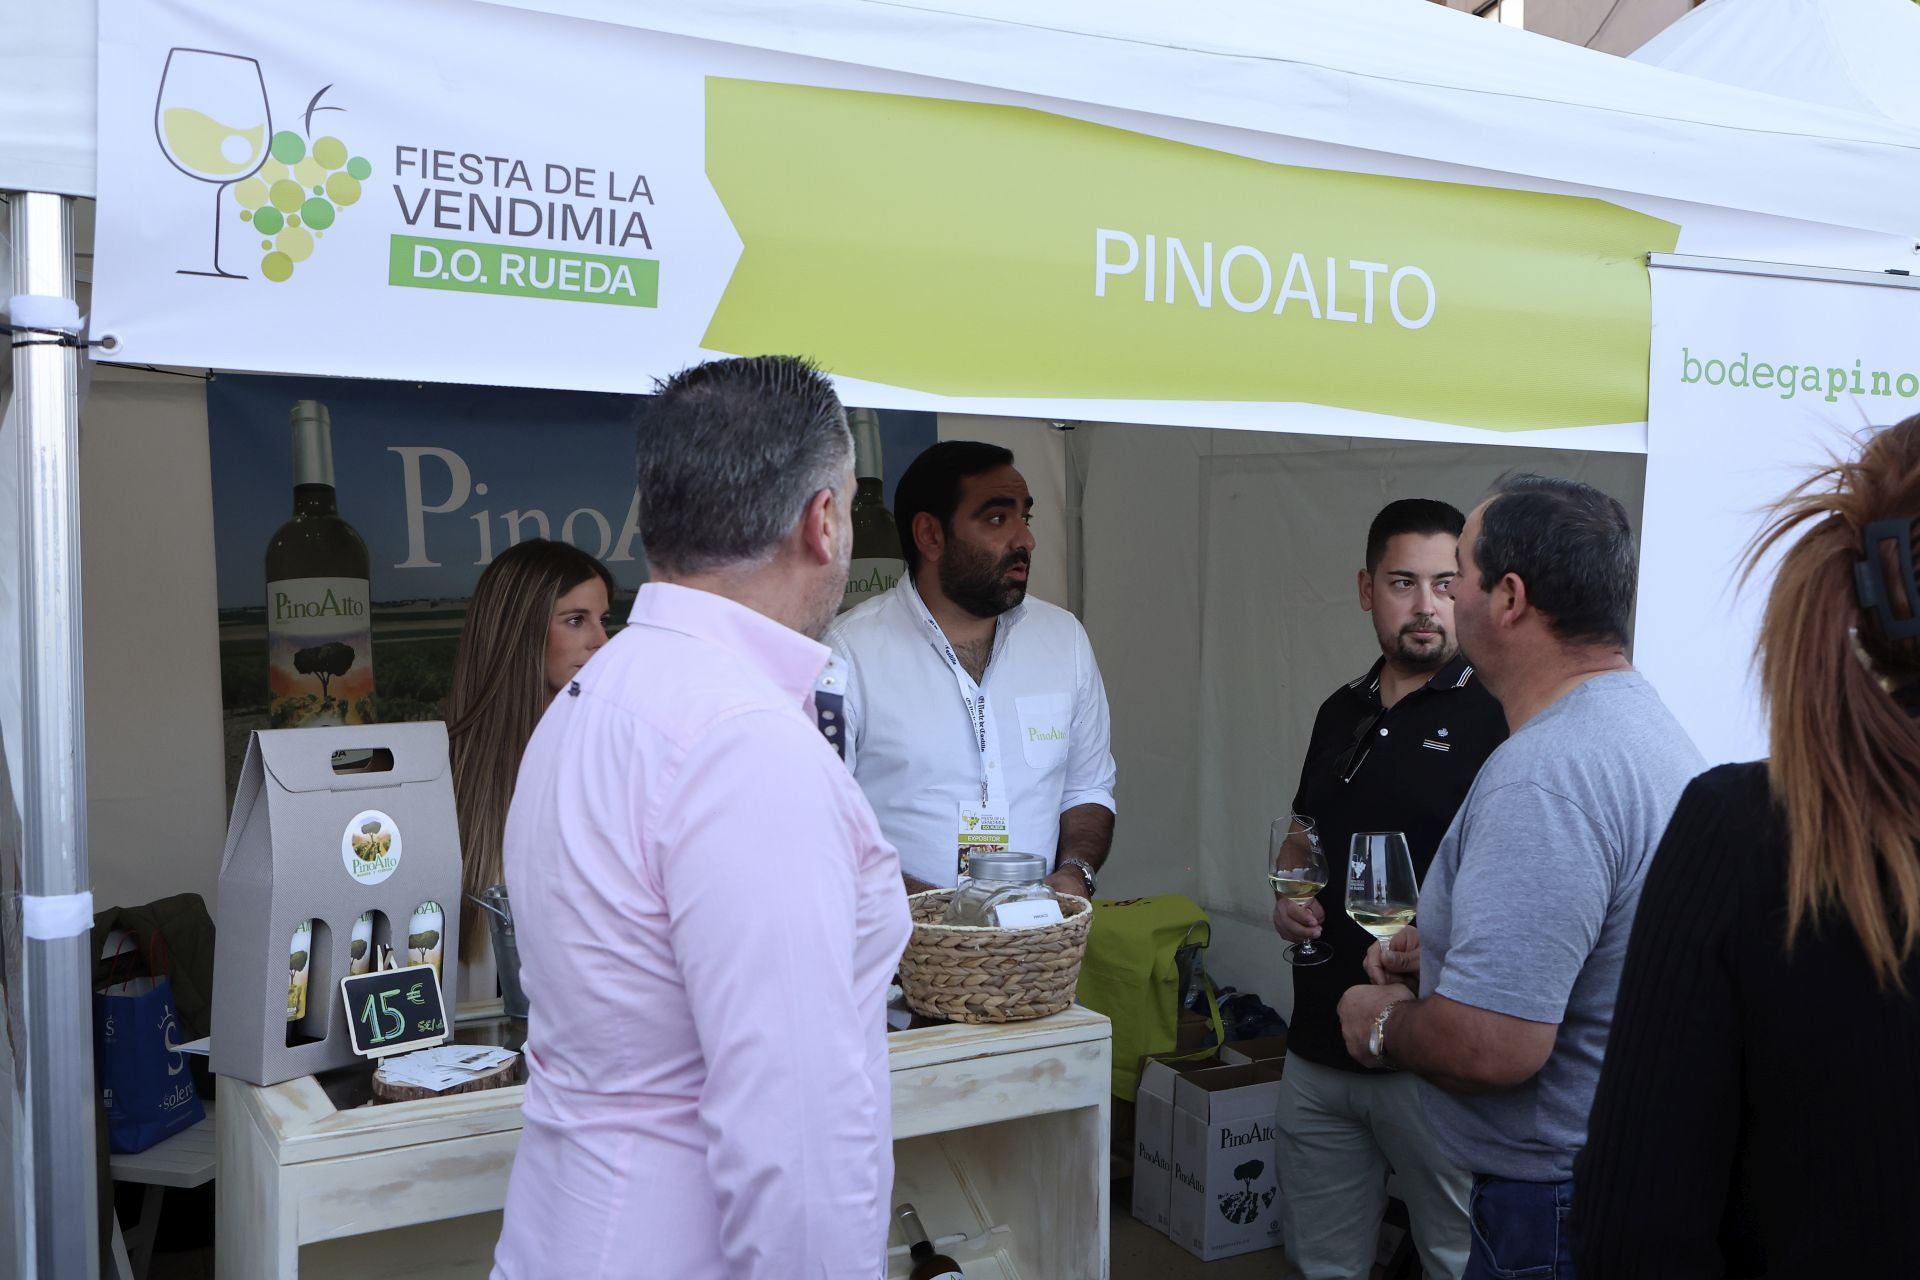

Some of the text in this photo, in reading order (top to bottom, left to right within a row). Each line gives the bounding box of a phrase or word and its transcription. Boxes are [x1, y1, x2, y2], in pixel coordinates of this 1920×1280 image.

[394, 145, 656, 205] FIESTA DE LA
[393, 184, 654, 250] VENDIMIA
[412, 245, 637, 297] D.O. RUEDA
[1095, 228, 1437, 330] PINOALTO
[1680, 347, 1920, 402] bodegapino
[275, 588, 364, 619] PinoAlto
[352, 854, 396, 874] PinoAlto
[1220, 1122, 1278, 1149] PinoAlto
[1139, 1142, 1170, 1172] PinoAlto
[1175, 1162, 1205, 1194] PinoAlto
